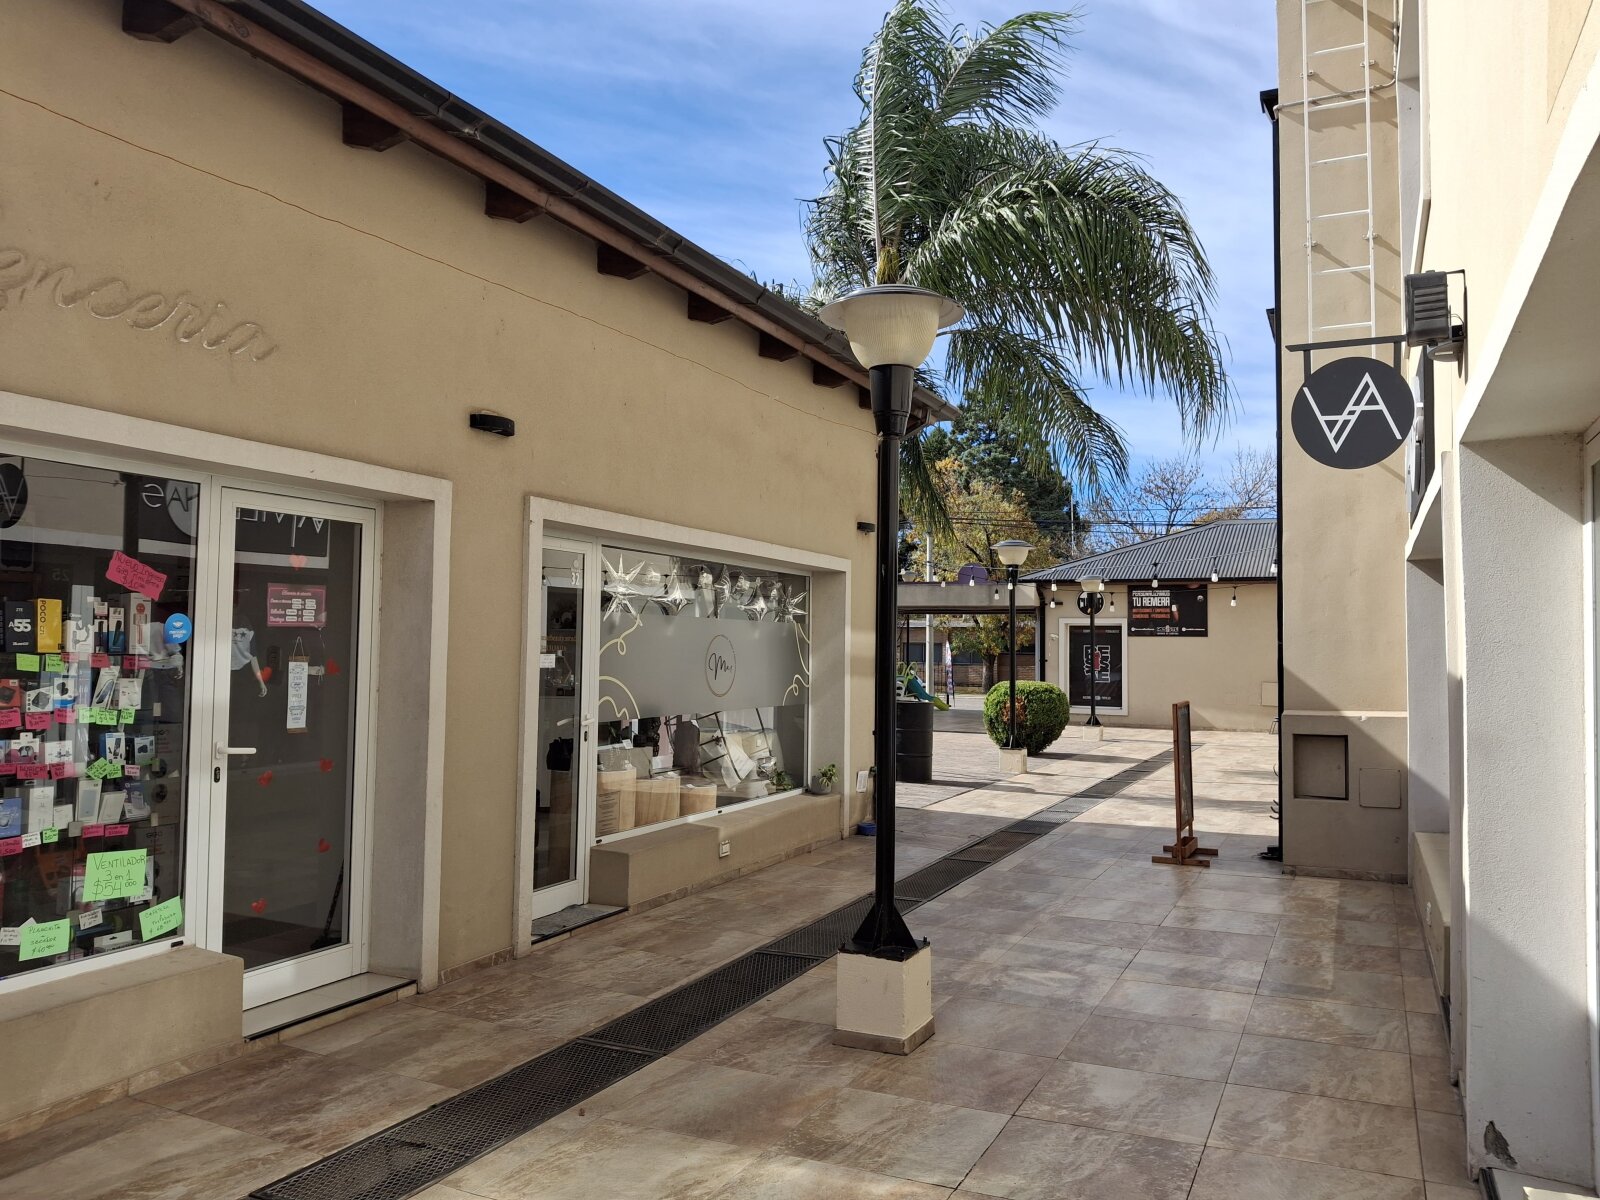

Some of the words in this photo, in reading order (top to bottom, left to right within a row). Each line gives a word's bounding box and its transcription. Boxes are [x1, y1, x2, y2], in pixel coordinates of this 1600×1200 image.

[1133, 597, 1141, 606] TU
[1142, 597, 1170, 607] REMERA
[93, 853, 146, 871] VENTILADOR
[103, 869, 112, 881] 3
[126, 869, 134, 881] 1
